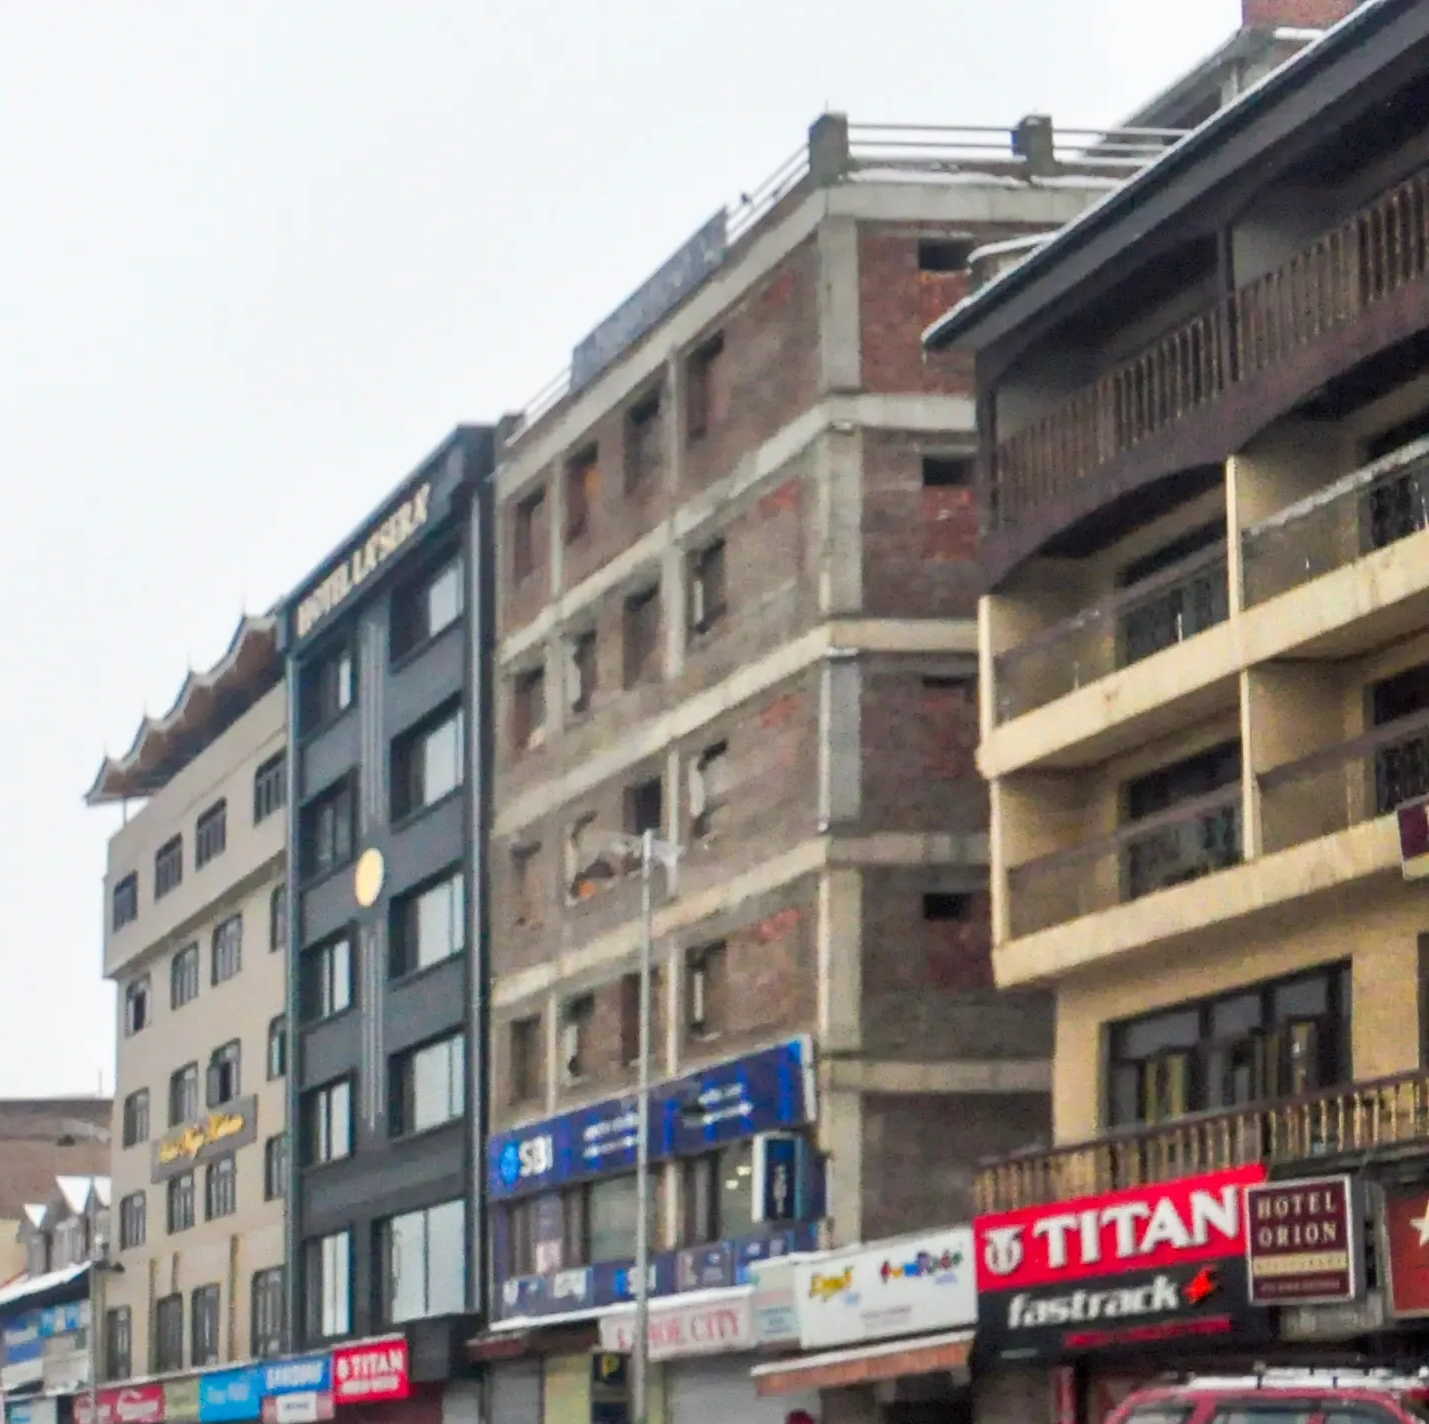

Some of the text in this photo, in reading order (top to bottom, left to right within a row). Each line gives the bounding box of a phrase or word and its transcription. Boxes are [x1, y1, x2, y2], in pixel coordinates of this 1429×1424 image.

[519, 1134, 553, 1177] SBI
[1256, 1190, 1337, 1220] HOTEL
[1032, 1184, 1239, 1268] TITAN
[1258, 1221, 1338, 1248] ORION
[1007, 1275, 1180, 1329] fastrack
[691, 1308, 740, 1342] CITY
[353, 1348, 404, 1379] TITAN
